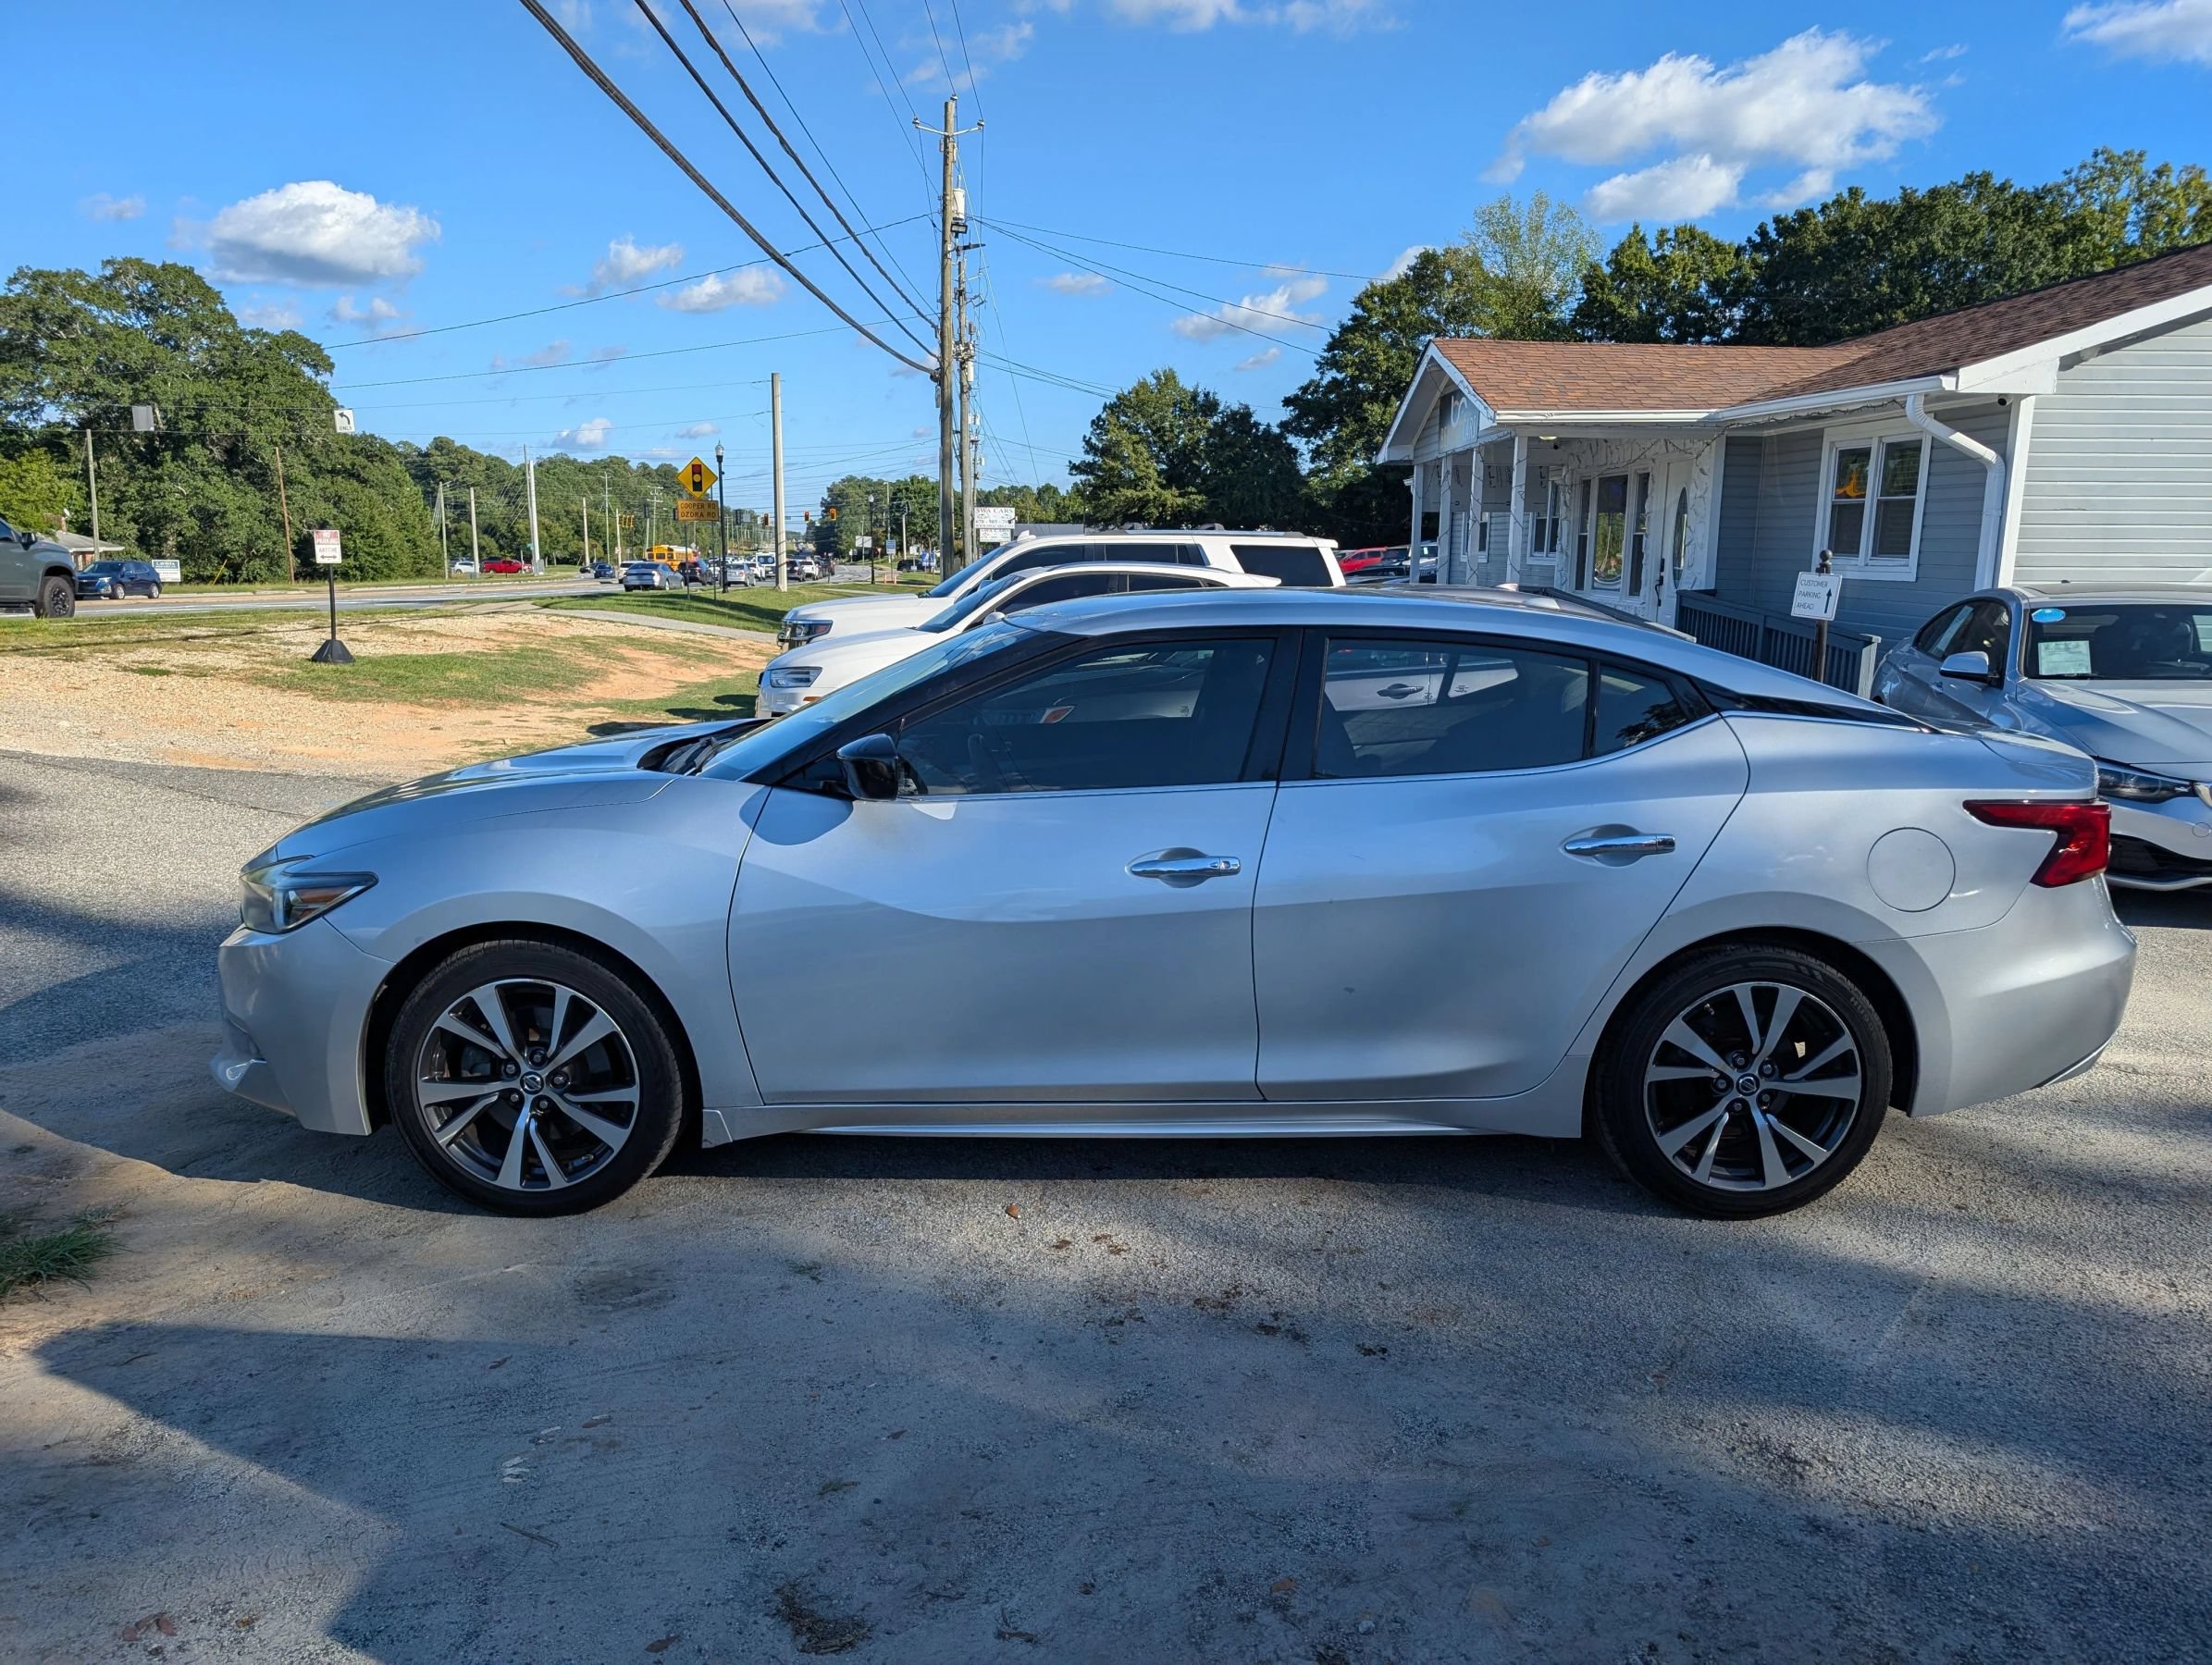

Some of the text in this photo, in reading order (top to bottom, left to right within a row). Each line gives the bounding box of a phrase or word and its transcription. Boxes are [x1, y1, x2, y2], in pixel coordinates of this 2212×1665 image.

[1799, 579, 1828, 588] CUSTOMER
[1798, 590, 1822, 599] PARKING
[1796, 601, 1814, 610] AHEAD
